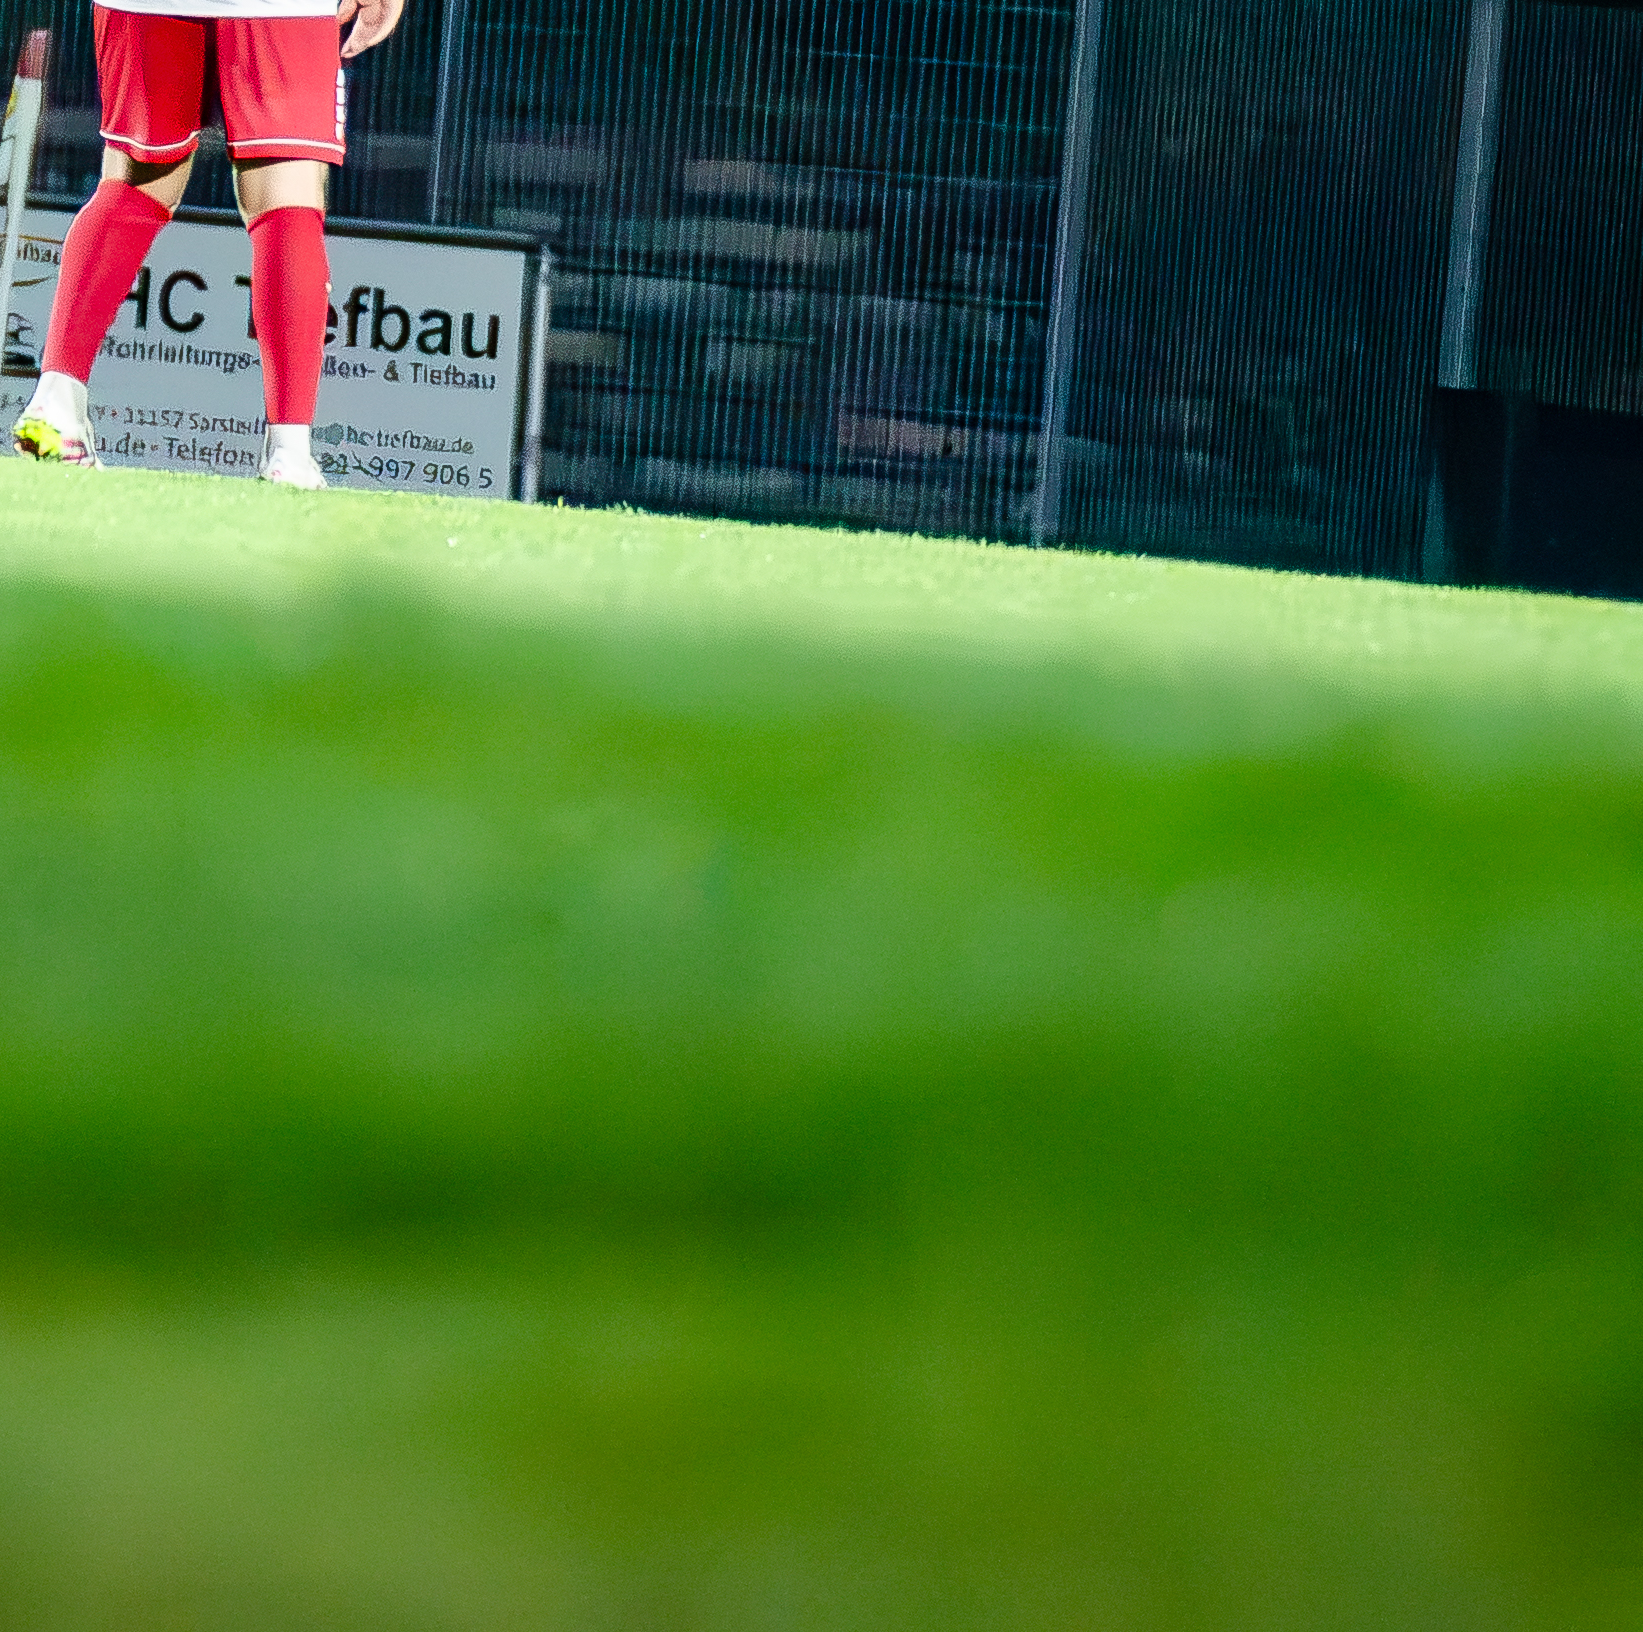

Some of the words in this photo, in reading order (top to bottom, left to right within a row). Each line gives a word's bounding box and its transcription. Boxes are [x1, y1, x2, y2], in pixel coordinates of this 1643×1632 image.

[234, 275, 500, 360] Tfbau
[410, 361, 497, 391] Tiefbau
[423, 462, 470, 488] 906
[478, 467, 493, 489] 5
